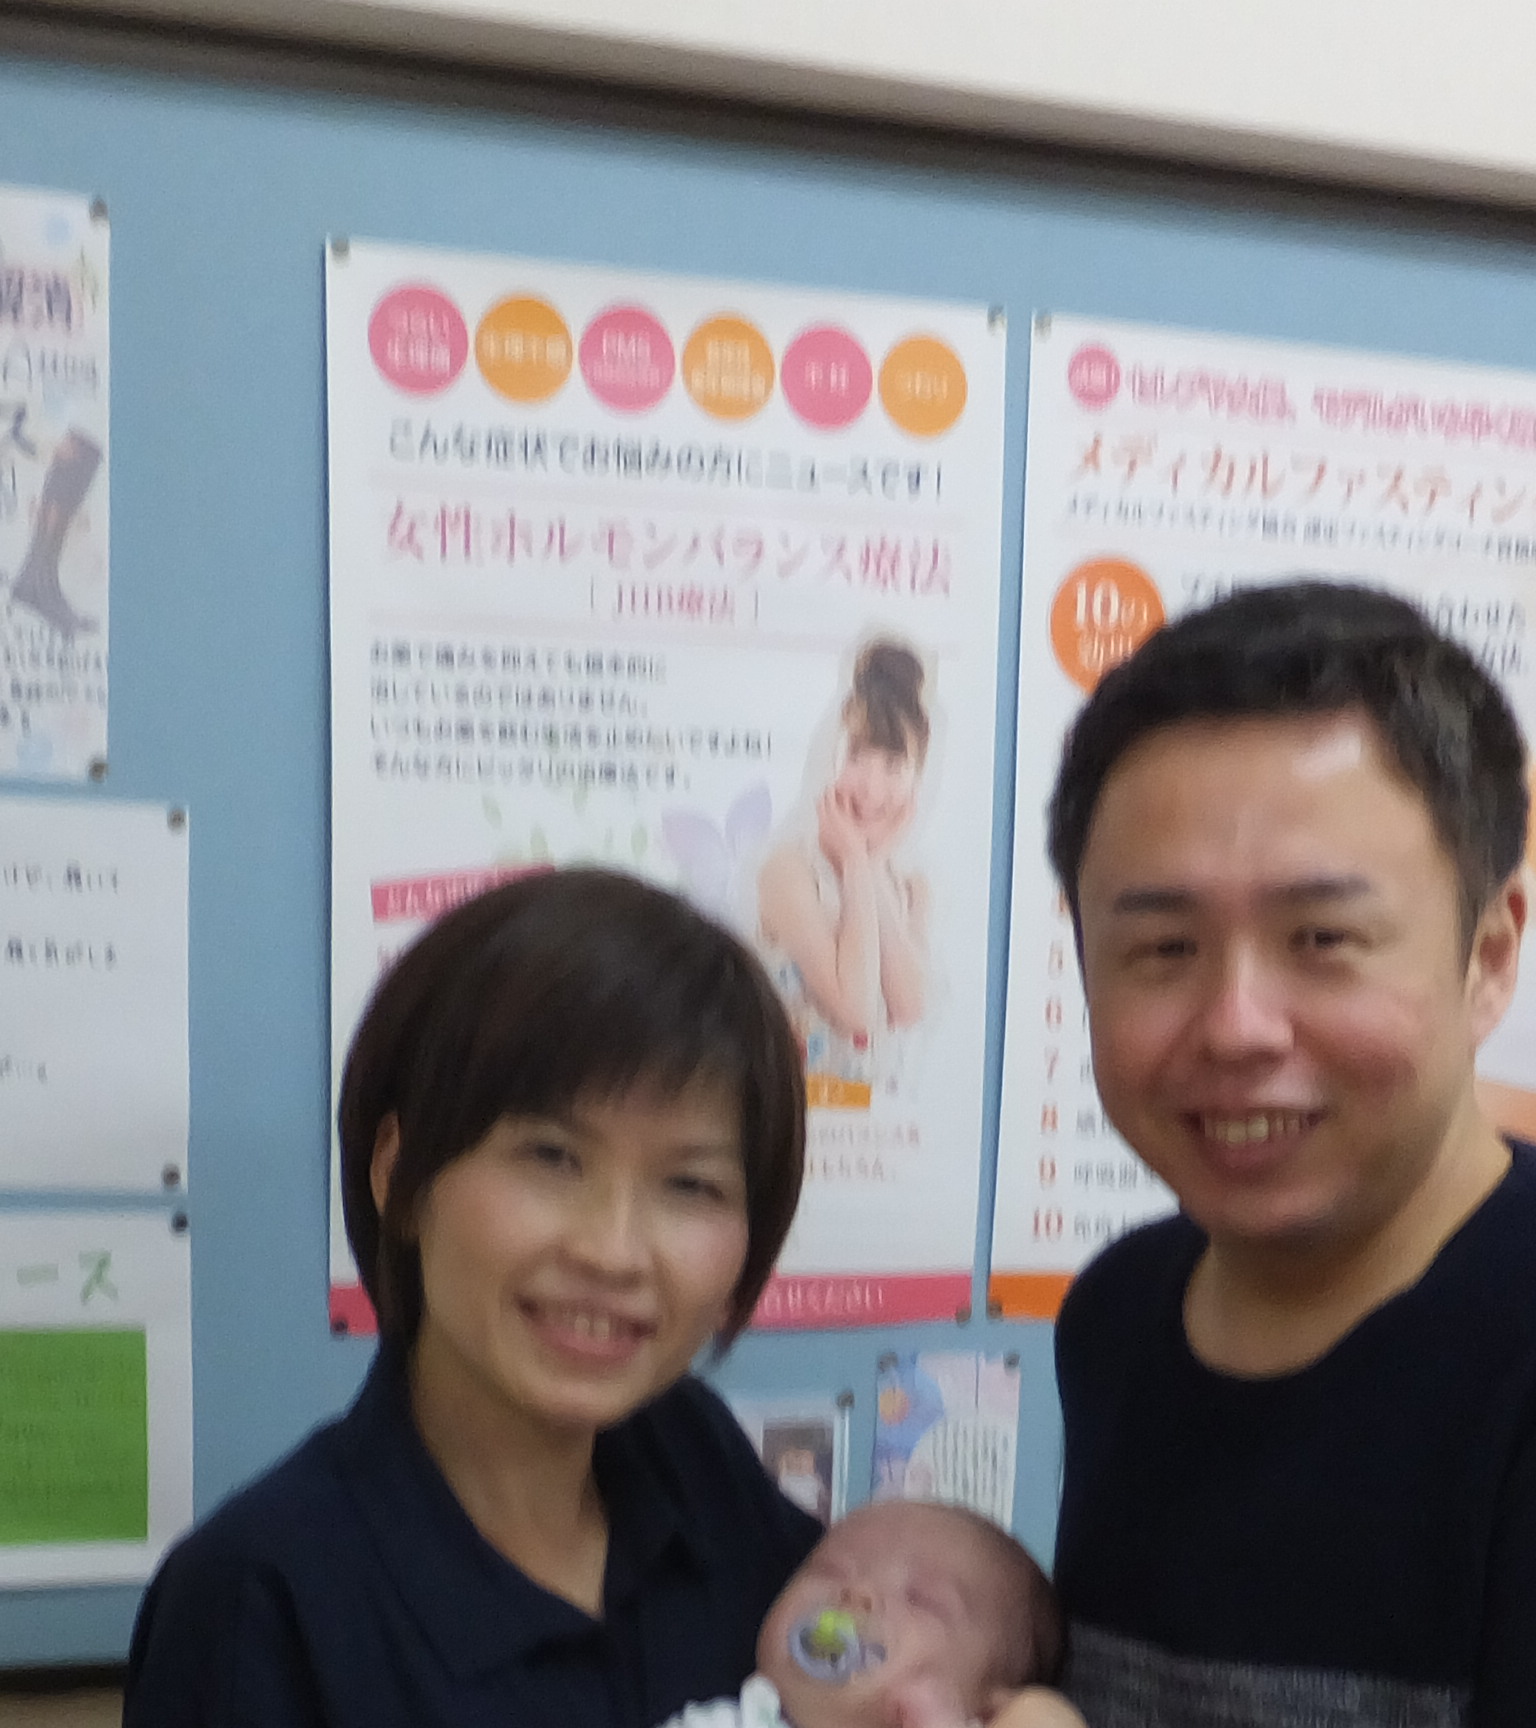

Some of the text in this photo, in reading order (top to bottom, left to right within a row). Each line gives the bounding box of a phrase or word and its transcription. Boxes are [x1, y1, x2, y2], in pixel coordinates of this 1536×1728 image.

[385, 499, 953, 597] 女性ホルモンバランス療法
